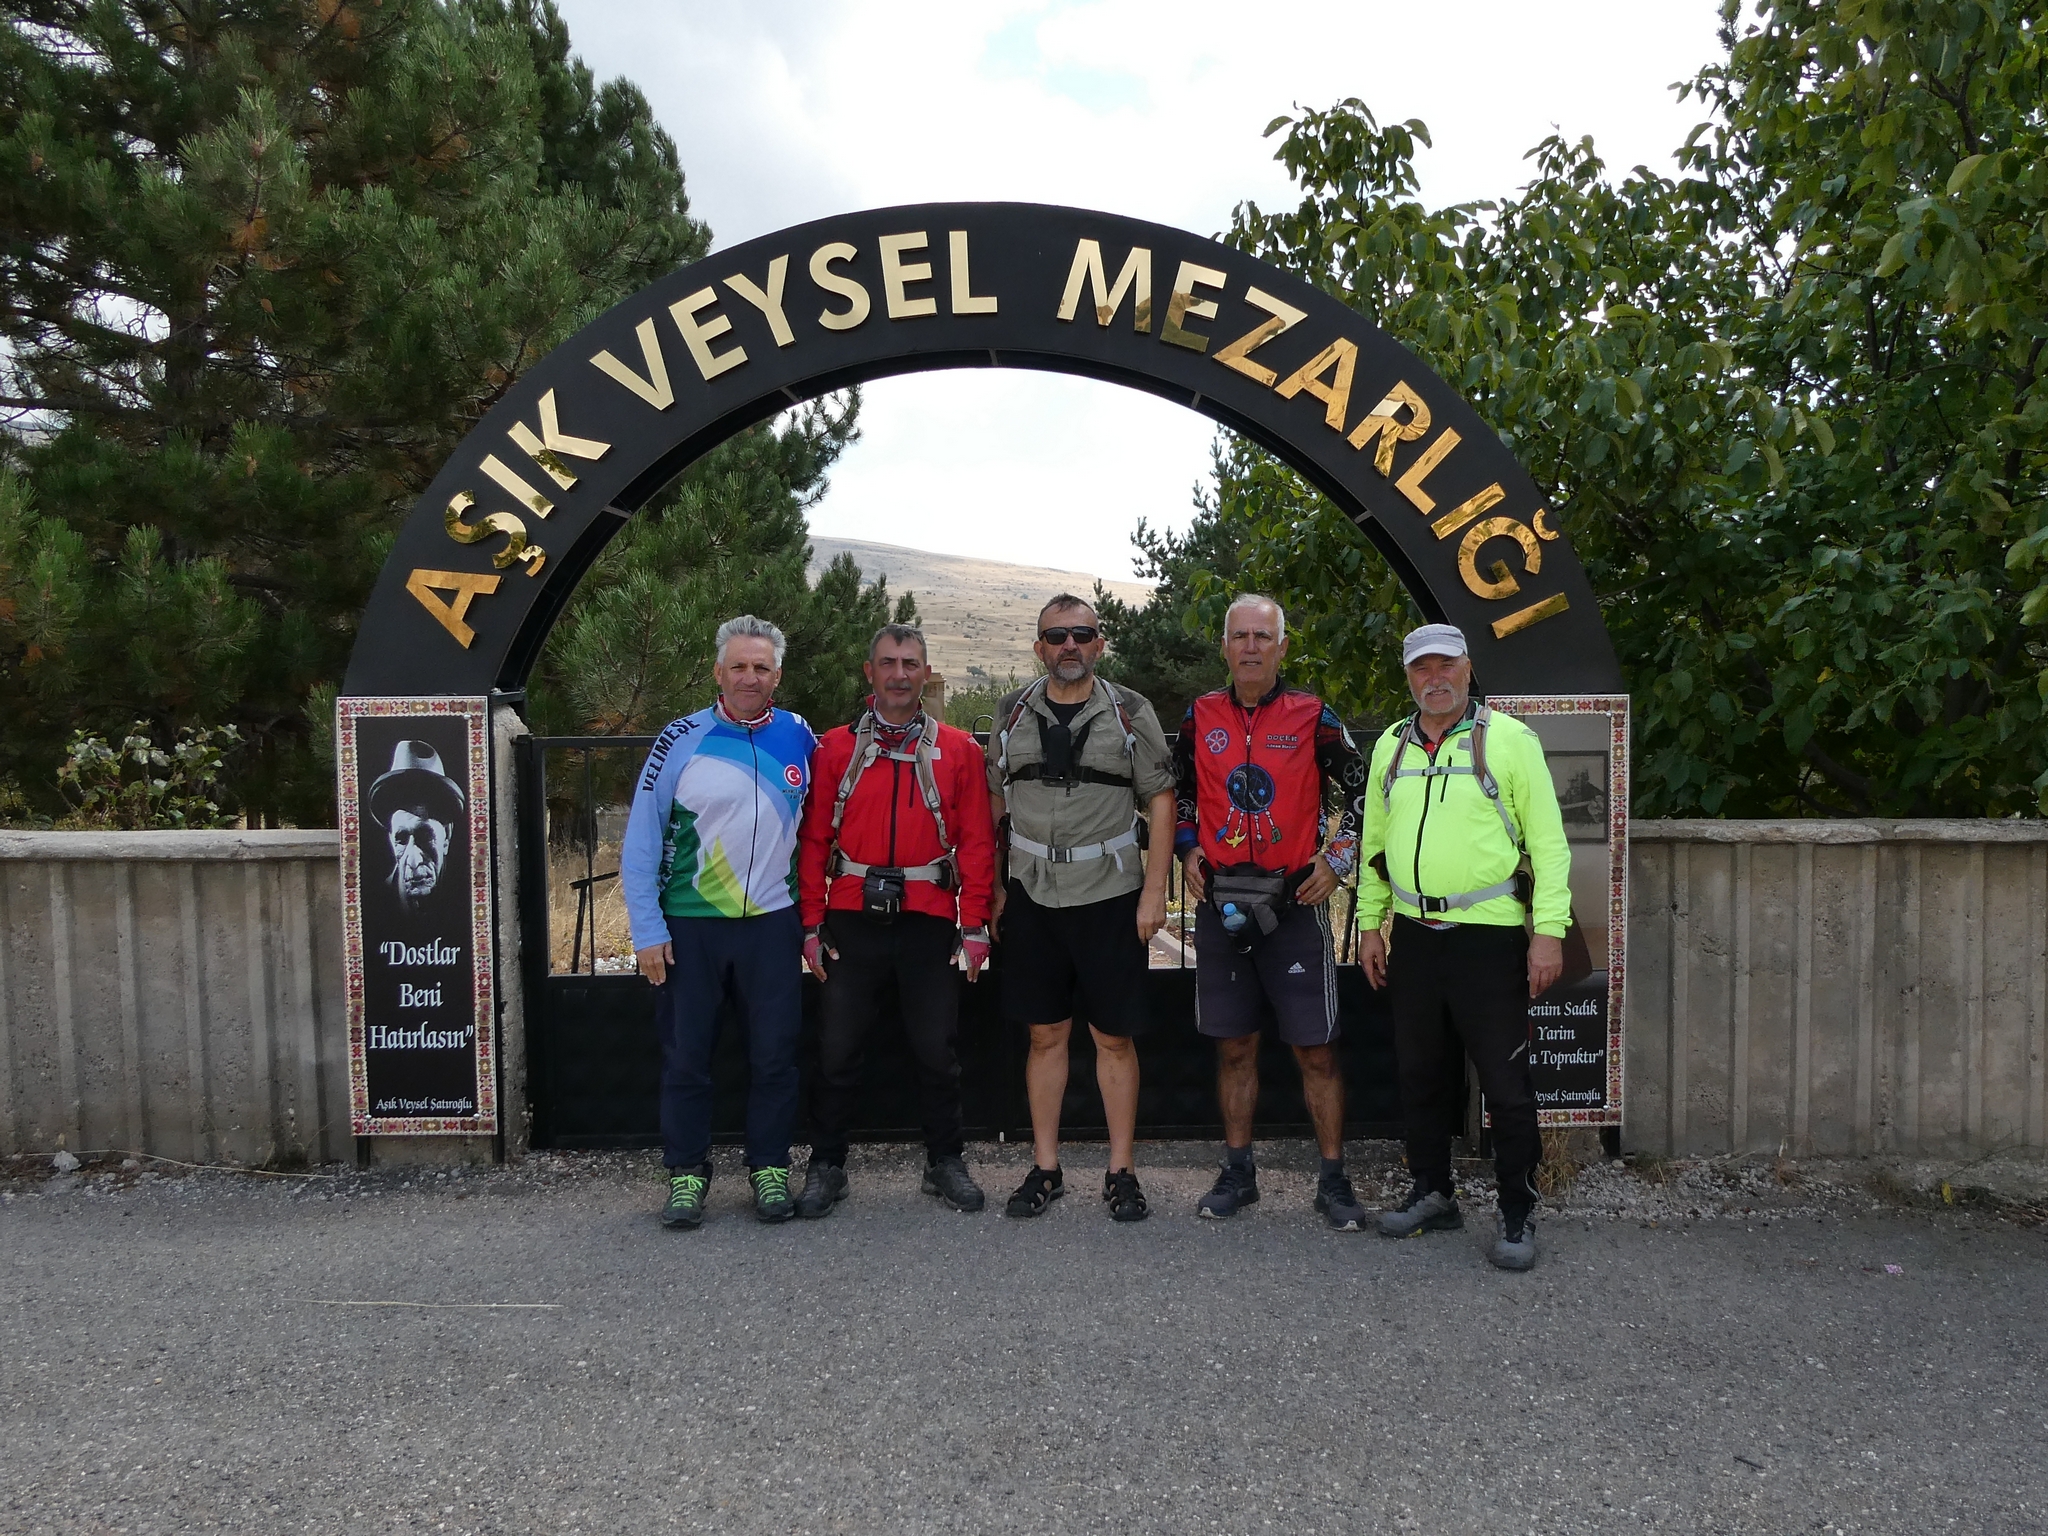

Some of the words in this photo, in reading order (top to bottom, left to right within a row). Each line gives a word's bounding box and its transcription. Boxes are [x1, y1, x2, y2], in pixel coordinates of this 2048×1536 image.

[405, 387, 612, 649] AŞIK
[589, 230, 998, 411] VEYSEL
[1056, 238, 1570, 639] MEZARLIĞI
[399, 981, 444, 1007] Beni
[1528, 1001, 1561, 1016] enim
[1563, 999, 1598, 1016] Sadık
[1537, 1025, 1576, 1041] Yarim
[376, 1097, 397, 1111] Aşık
[398, 1097, 428, 1113] Veysel
[430, 1097, 473, 1113] Şatıroğlu
[1534, 1088, 1559, 1105] eysel
[1561, 1088, 1601, 1105] Şatıroğlu
